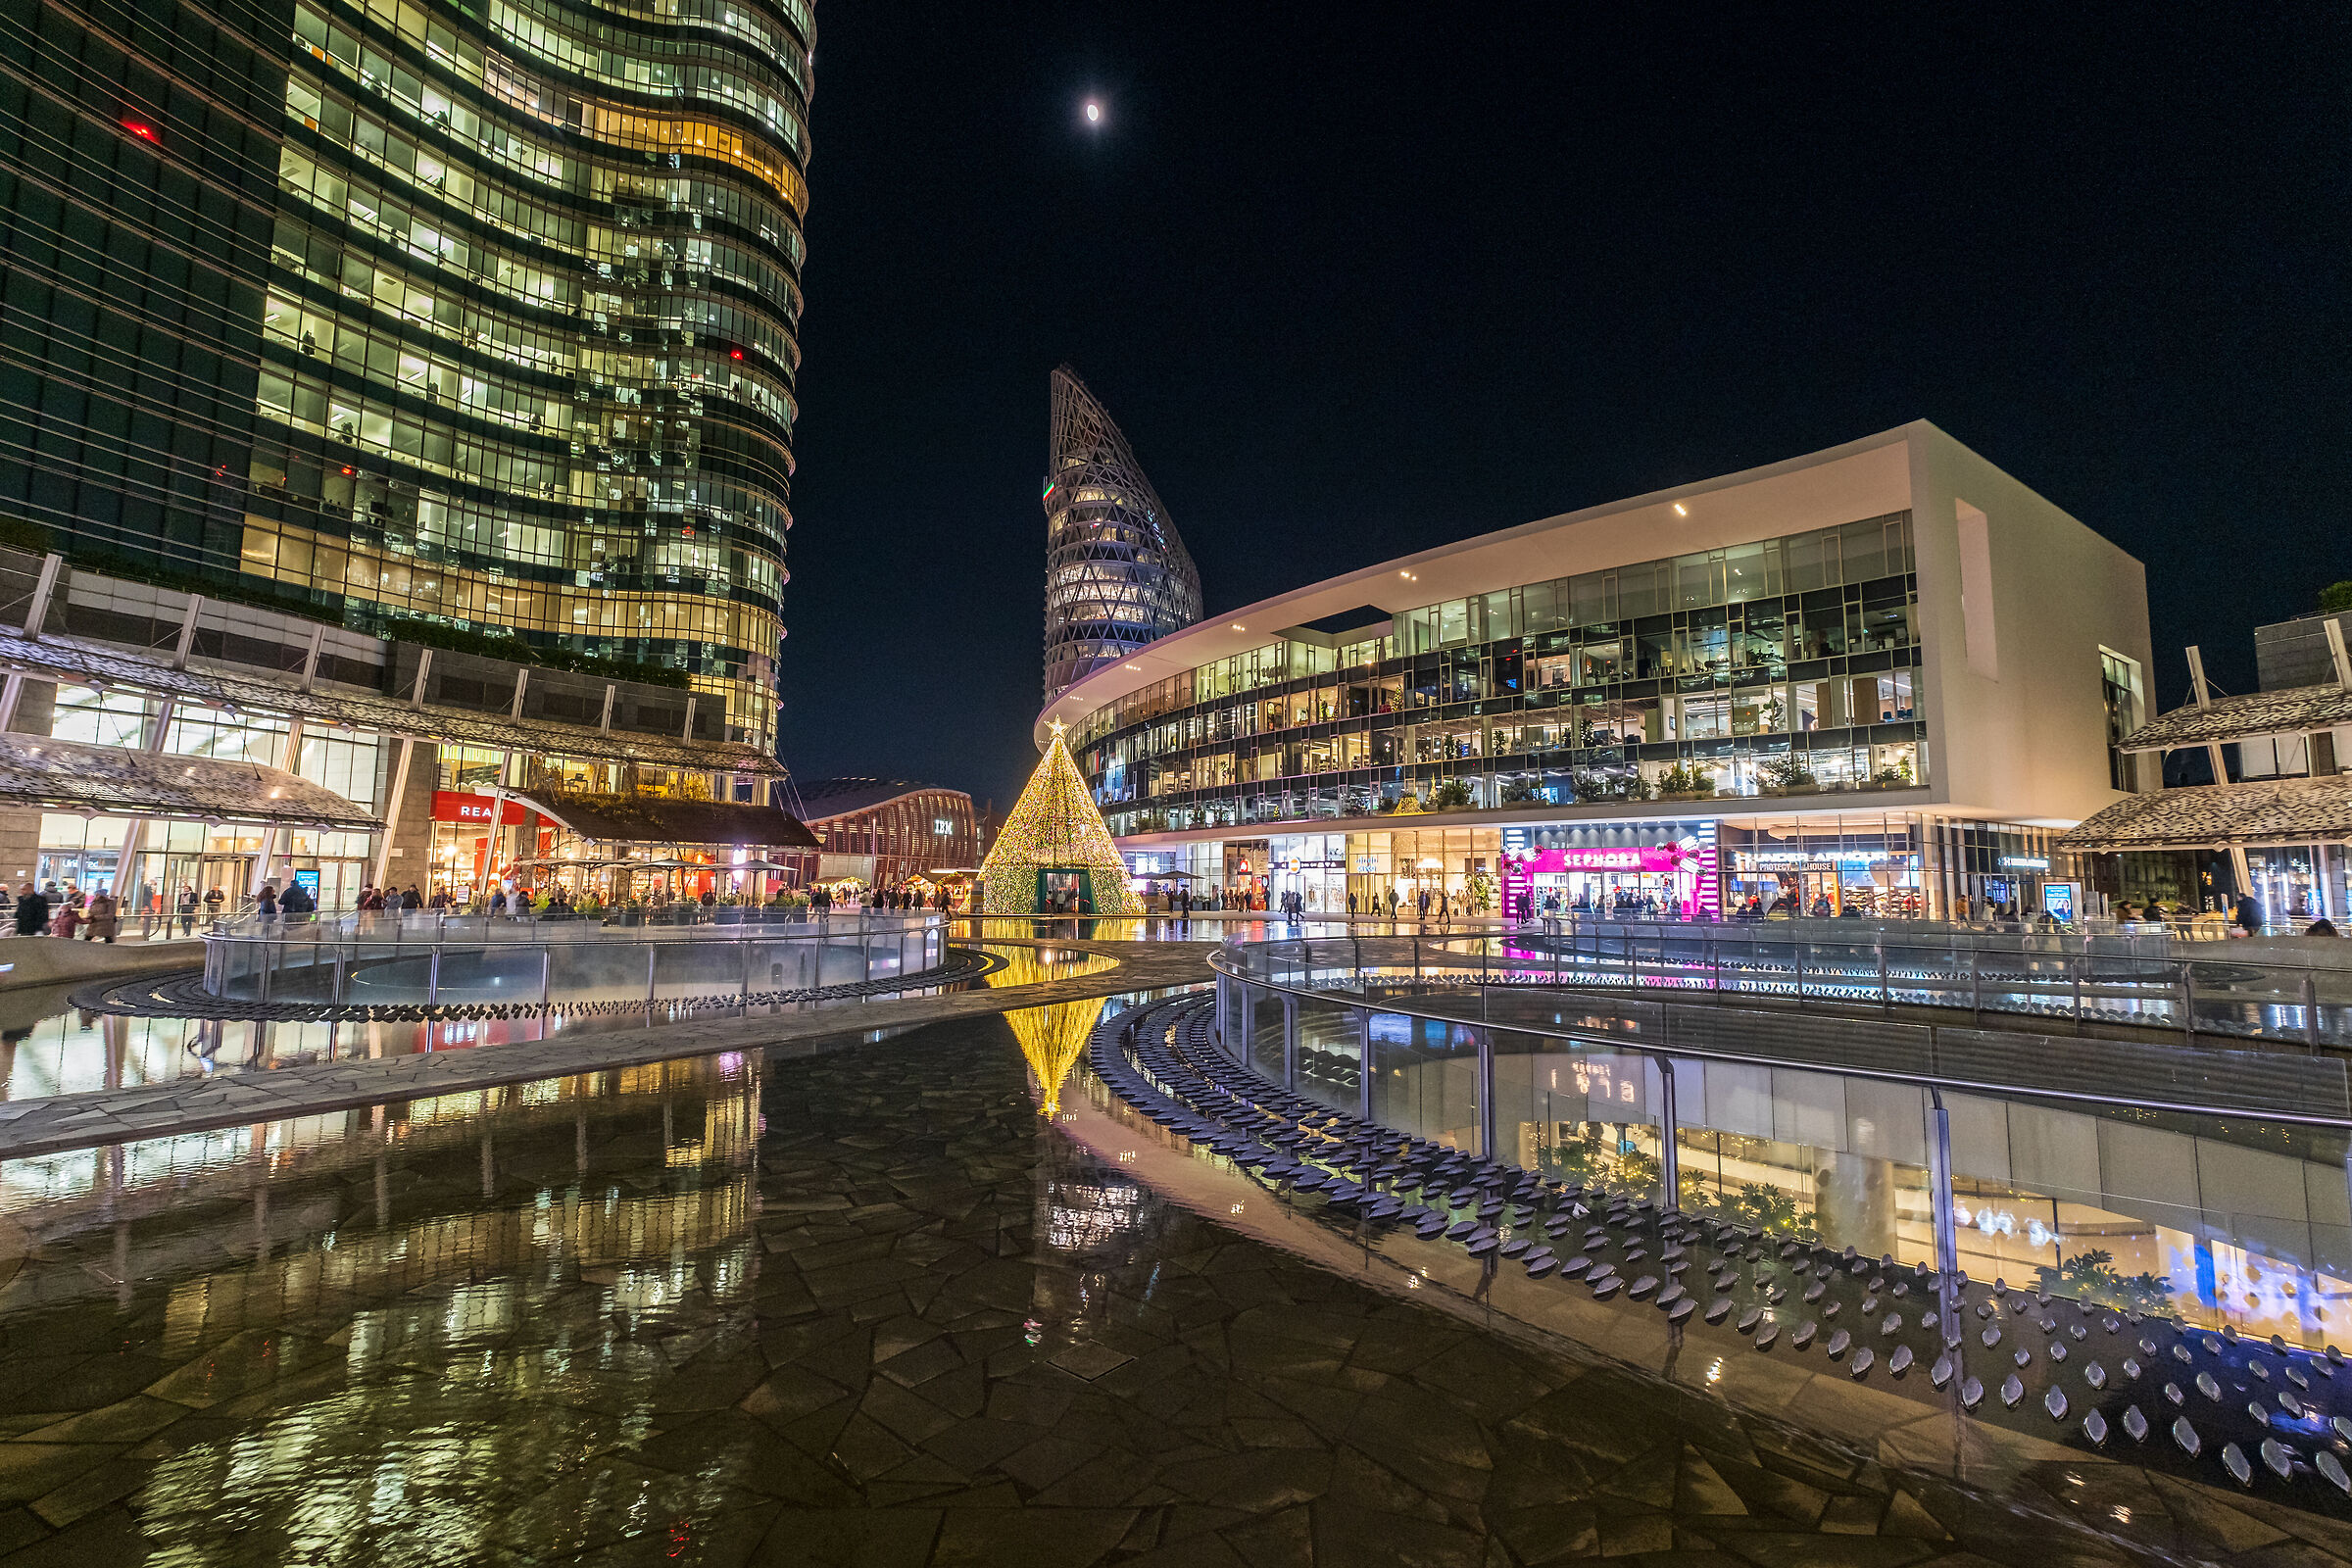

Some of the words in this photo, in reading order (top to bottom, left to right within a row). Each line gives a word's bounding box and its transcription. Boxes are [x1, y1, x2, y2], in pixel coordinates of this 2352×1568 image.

[461, 806, 503, 817] REA
[934, 819, 953, 834] IBM
[1563, 854, 1642, 866] SEPHORA
[1754, 853, 1808, 862] UNDER
[1813, 852, 1887, 861] ARMOUR
[1806, 862, 1832, 871] HOUSE
